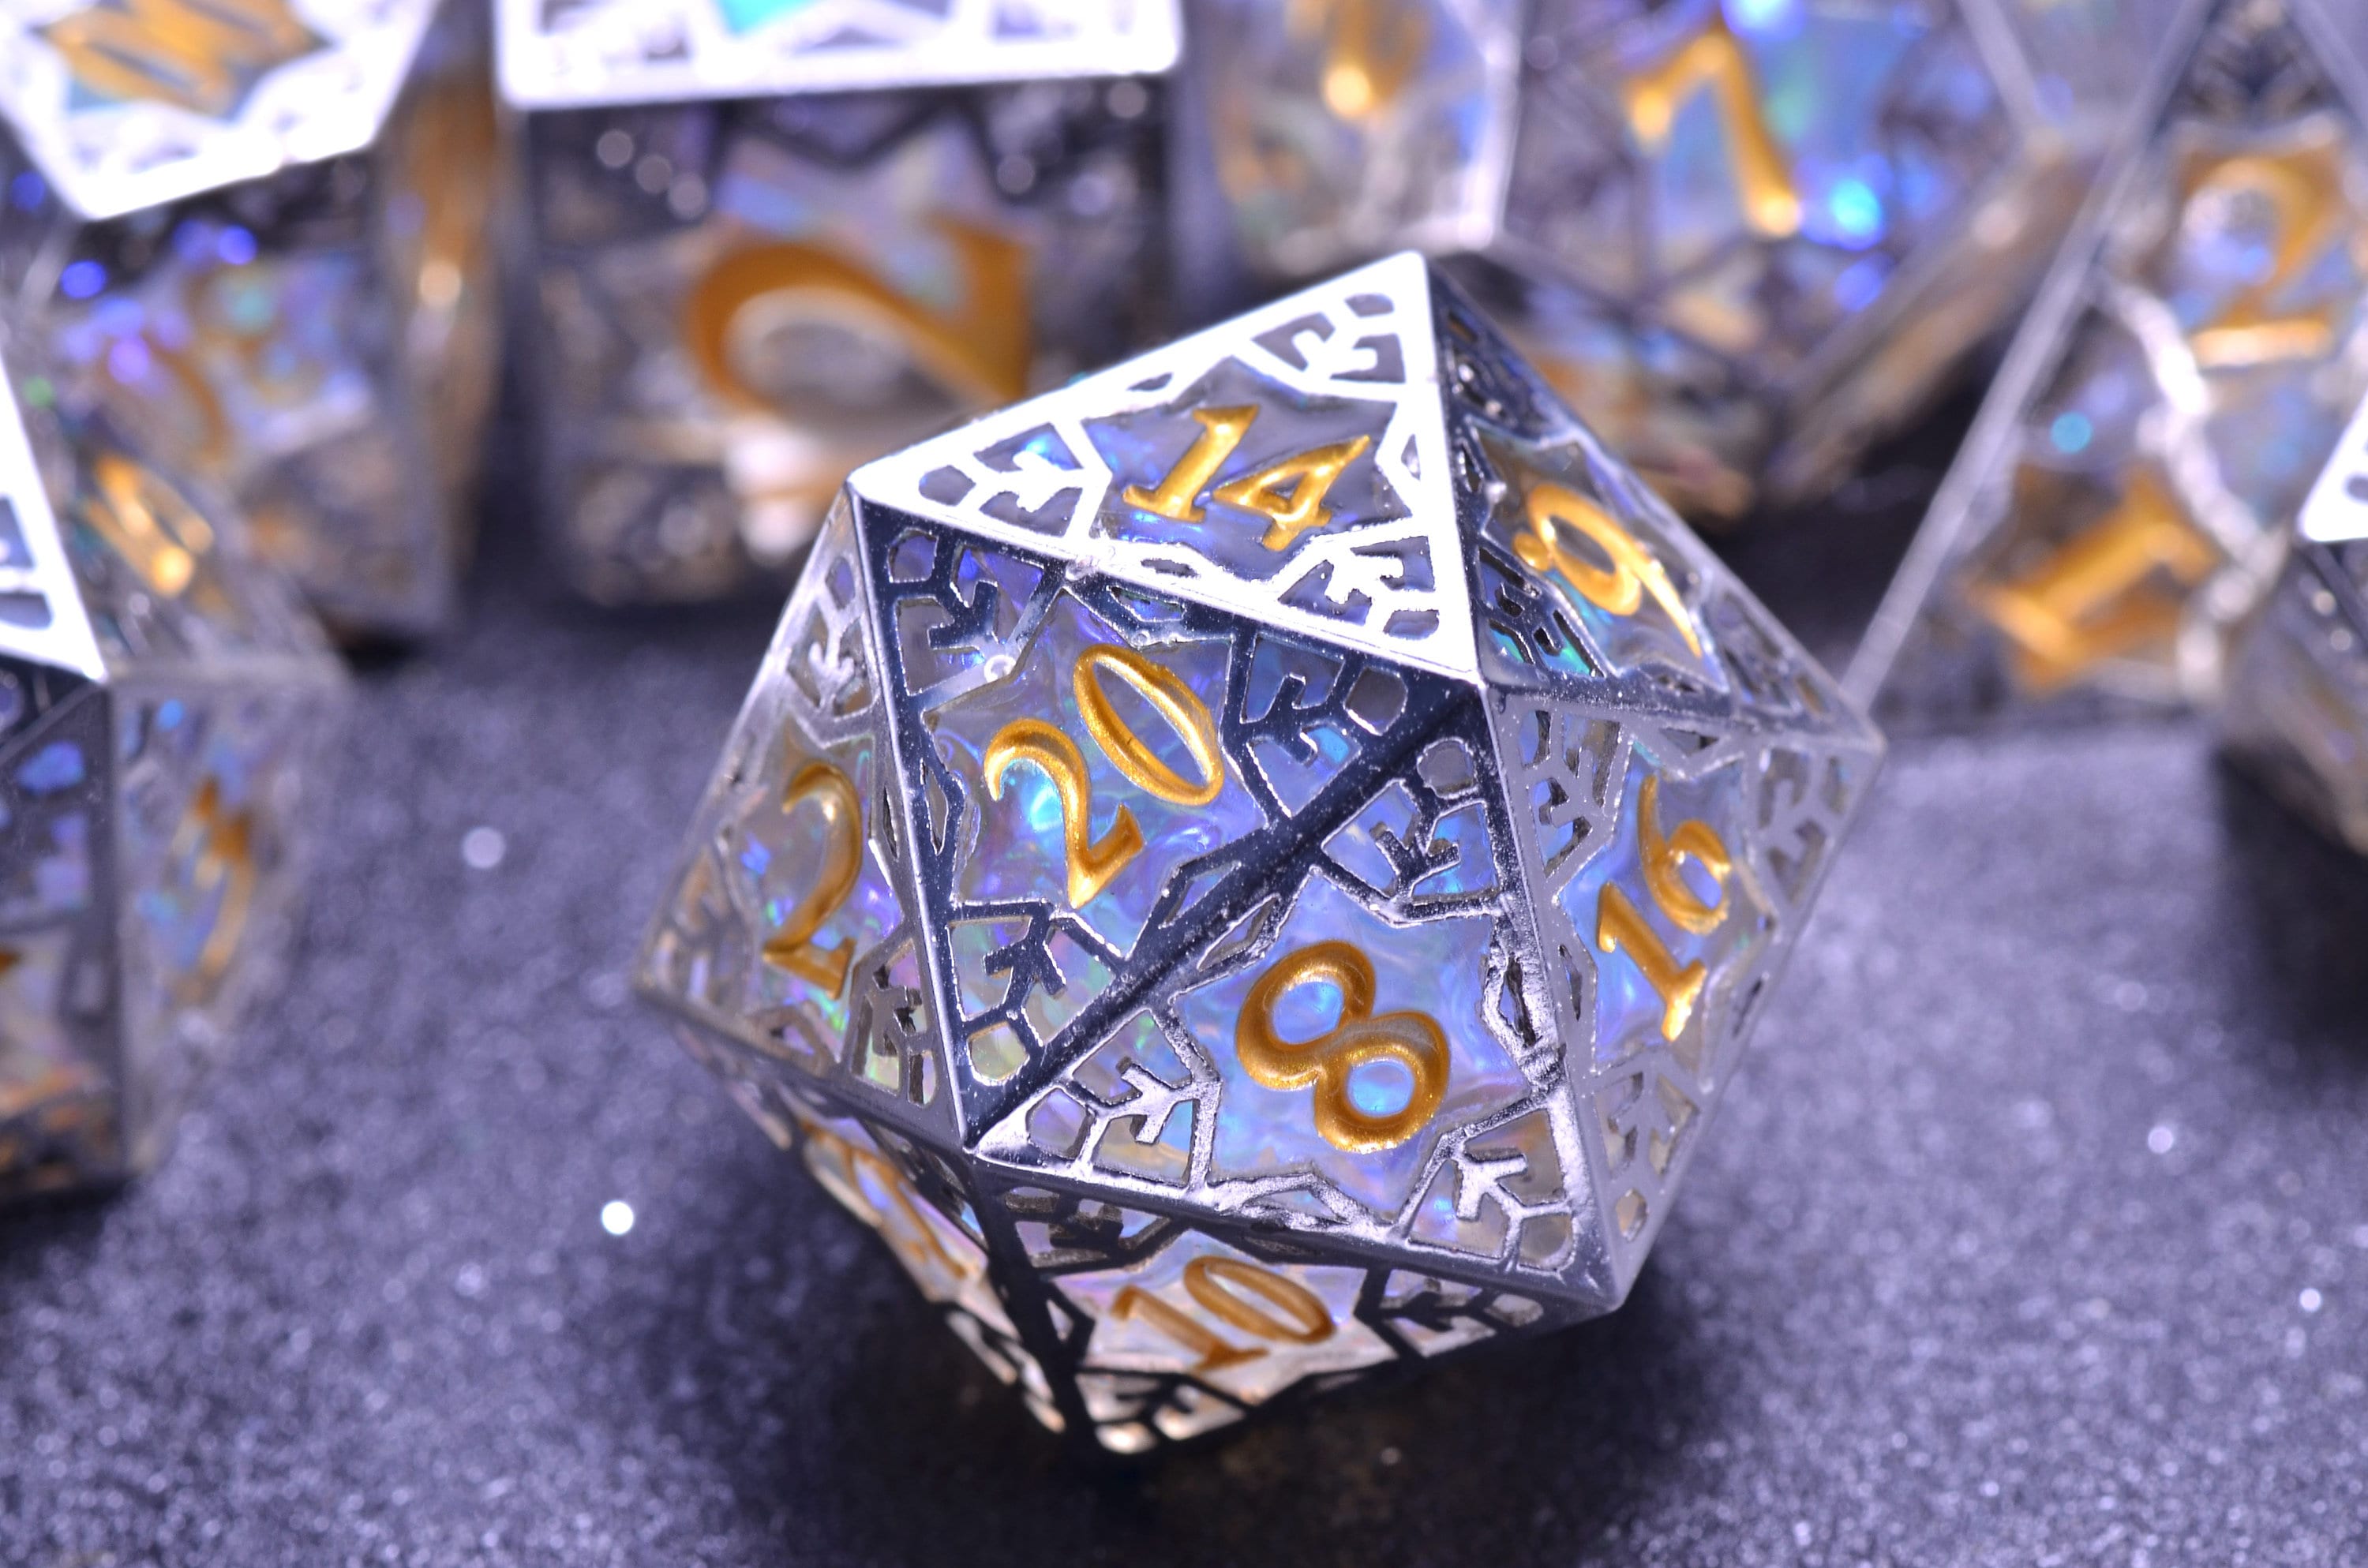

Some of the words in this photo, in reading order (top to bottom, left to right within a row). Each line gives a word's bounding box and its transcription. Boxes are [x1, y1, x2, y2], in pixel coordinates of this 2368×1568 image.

[2175, 154, 2340, 369] 2
[1122, 404, 1370, 552] 14
[762, 762, 864, 1001] 2
[984, 644, 1223, 910] 20
[1596, 774, 1733, 1042] 16
[1235, 938, 1452, 1154] 8
[1111, 1254, 1336, 1373] 10
